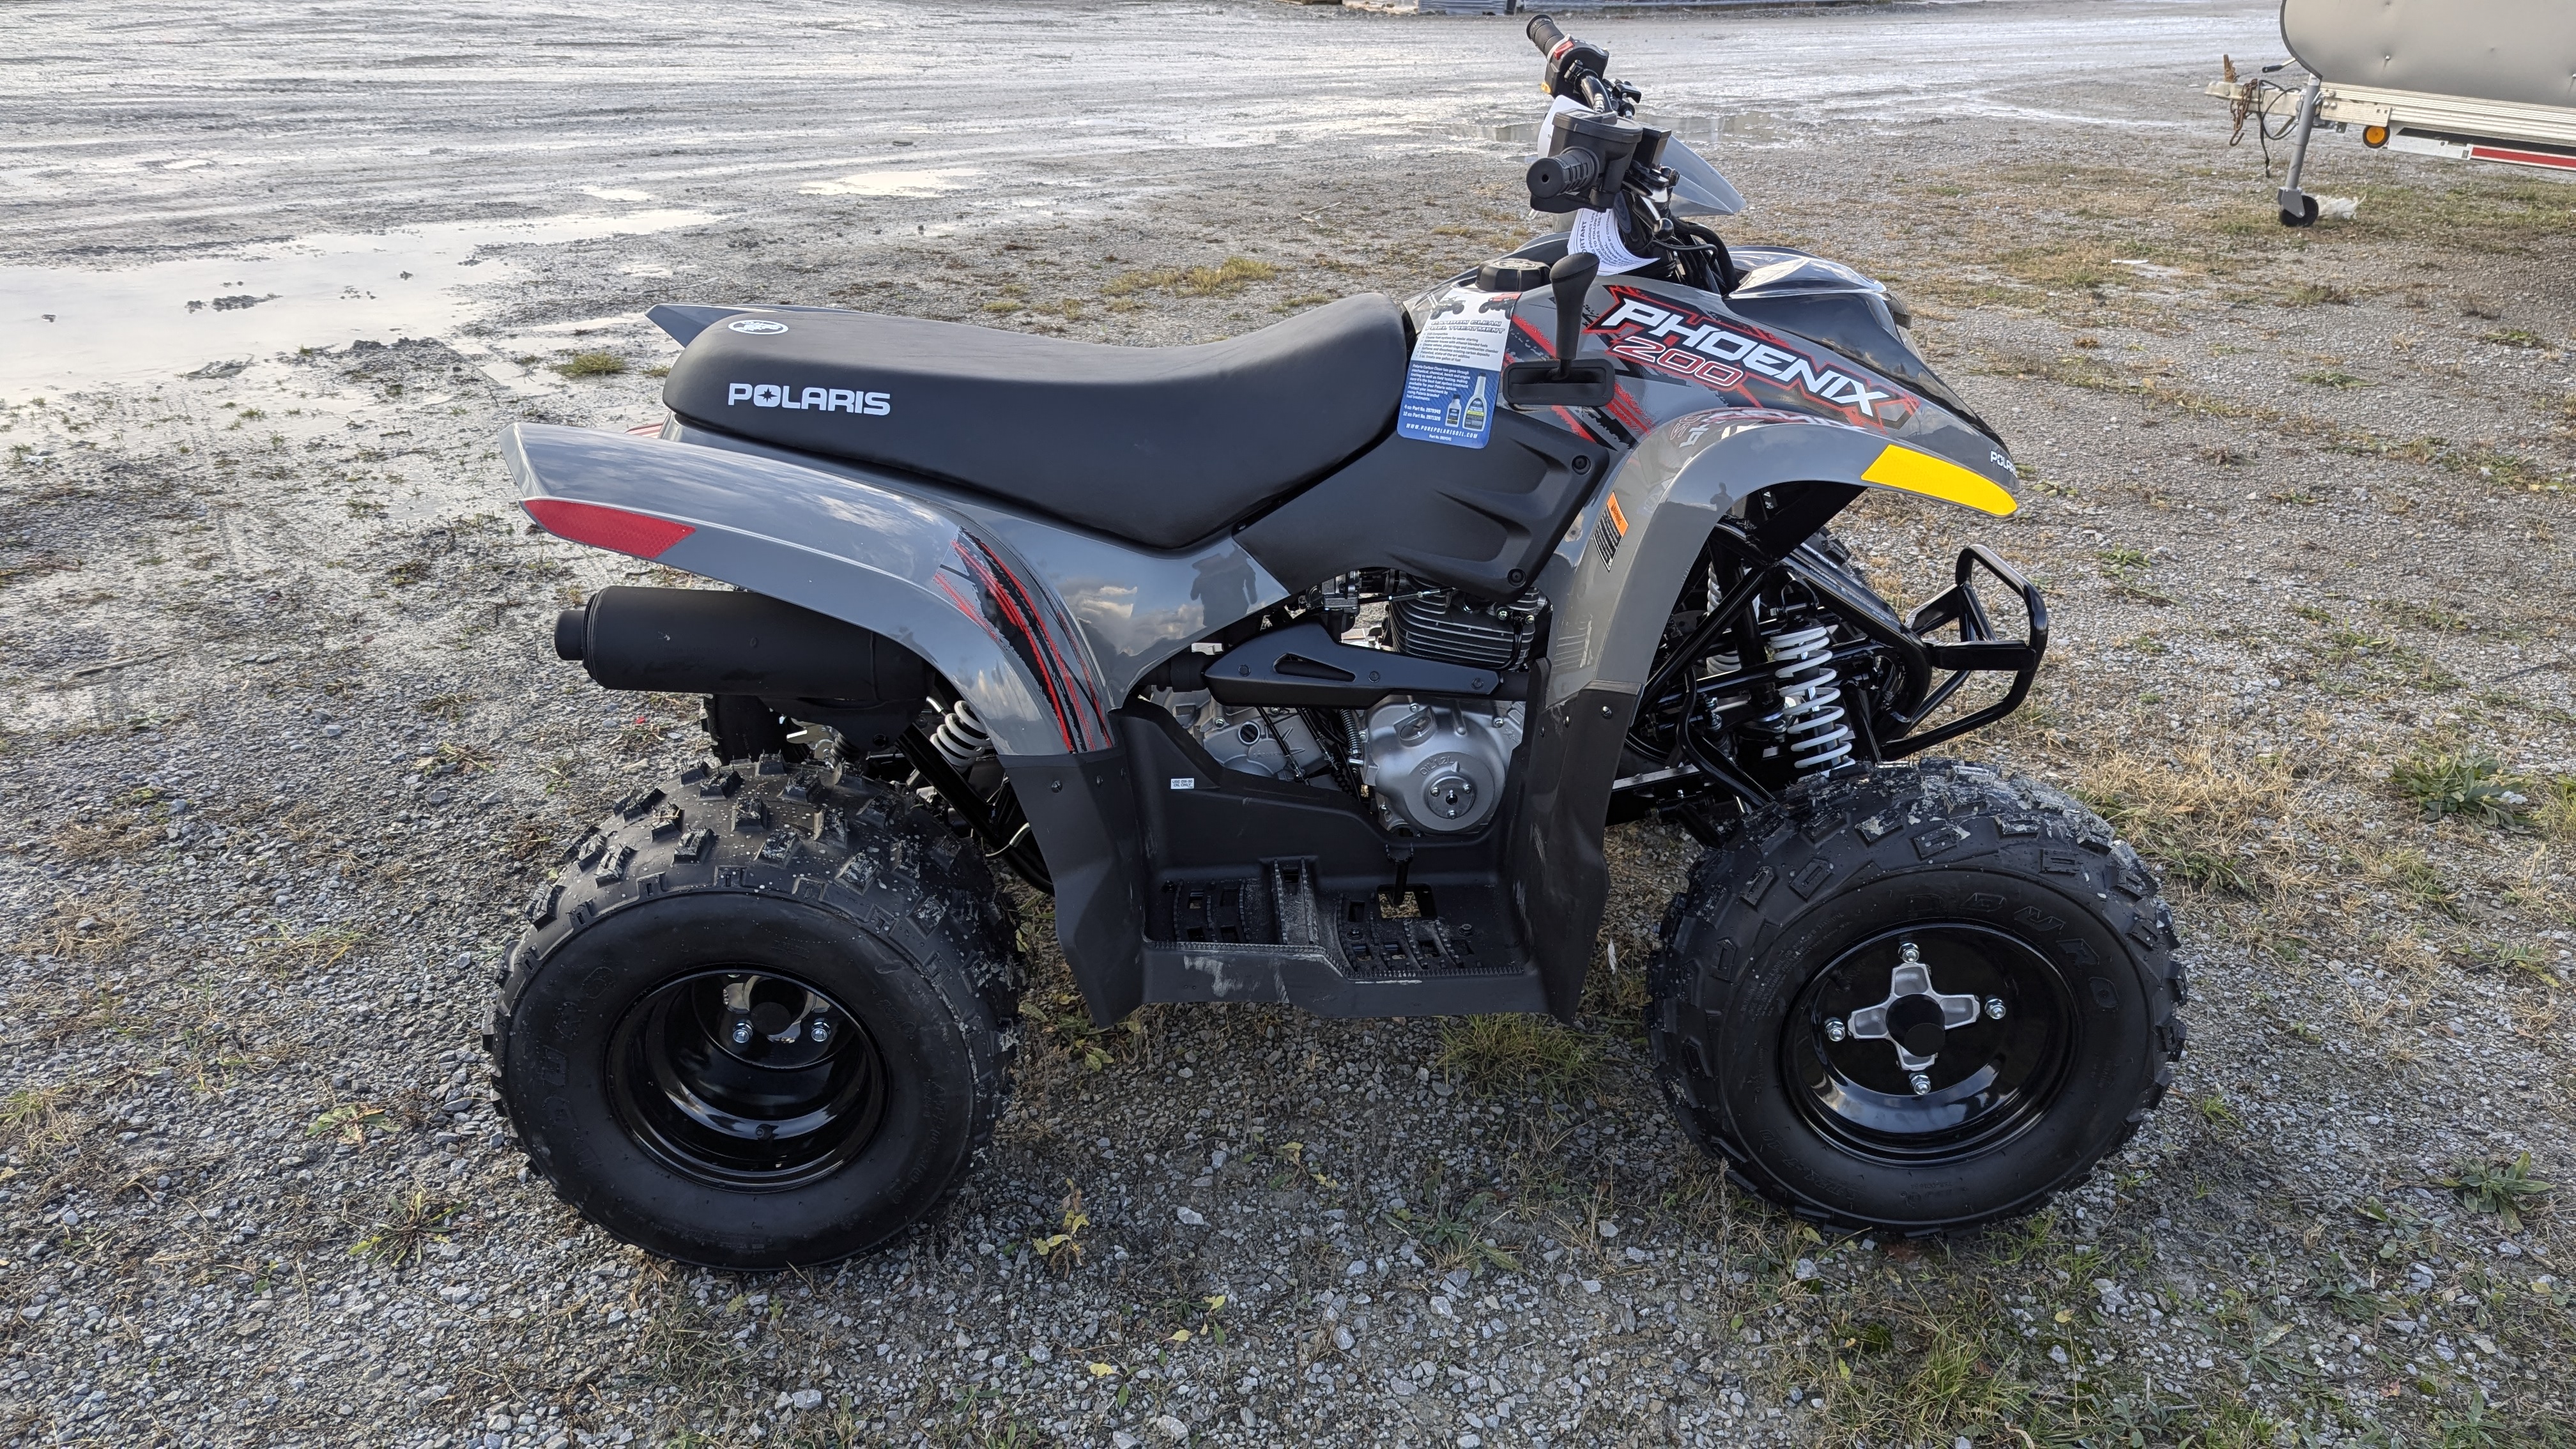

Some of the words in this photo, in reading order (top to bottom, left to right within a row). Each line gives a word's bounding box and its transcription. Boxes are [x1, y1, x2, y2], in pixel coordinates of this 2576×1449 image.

[1579, 222, 1588, 254] ORTANT
[1602, 298, 1889, 417] PHOENIX
[1613, 336, 1744, 387] 200
[728, 383, 891, 416] POLARIS
